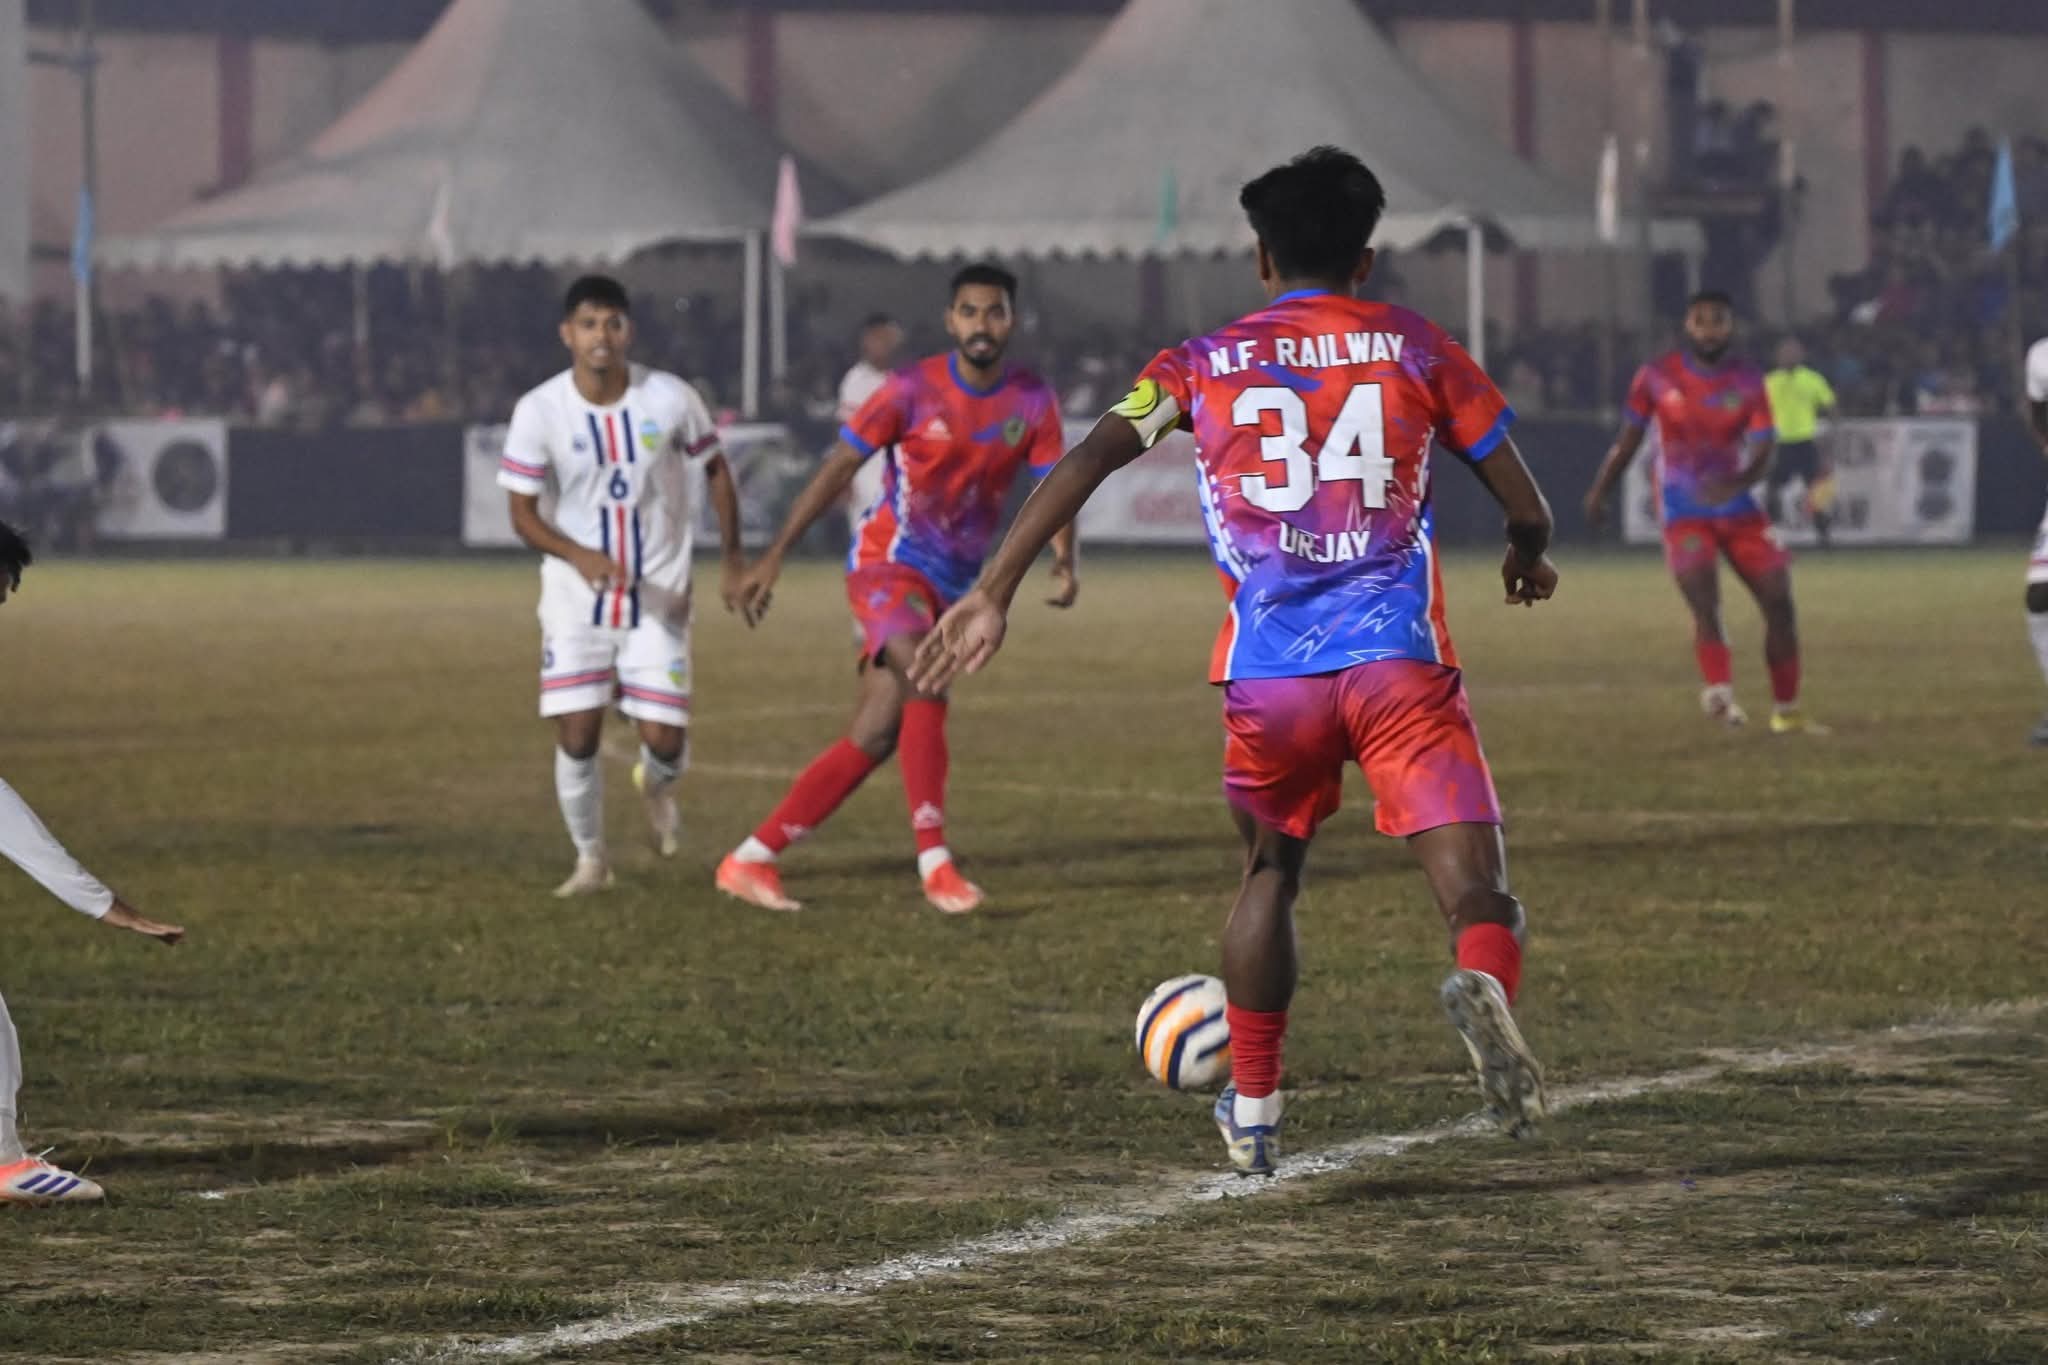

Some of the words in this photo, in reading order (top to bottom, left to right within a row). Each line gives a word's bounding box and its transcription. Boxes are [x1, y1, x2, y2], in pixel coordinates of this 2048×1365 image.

[1208, 340, 1269, 377] N.F.
[1275, 332, 1404, 367] RAILWAY
[1231, 382, 1396, 513] 34
[609, 467, 628, 500] 6
[1279, 520, 1370, 563] URJAY
